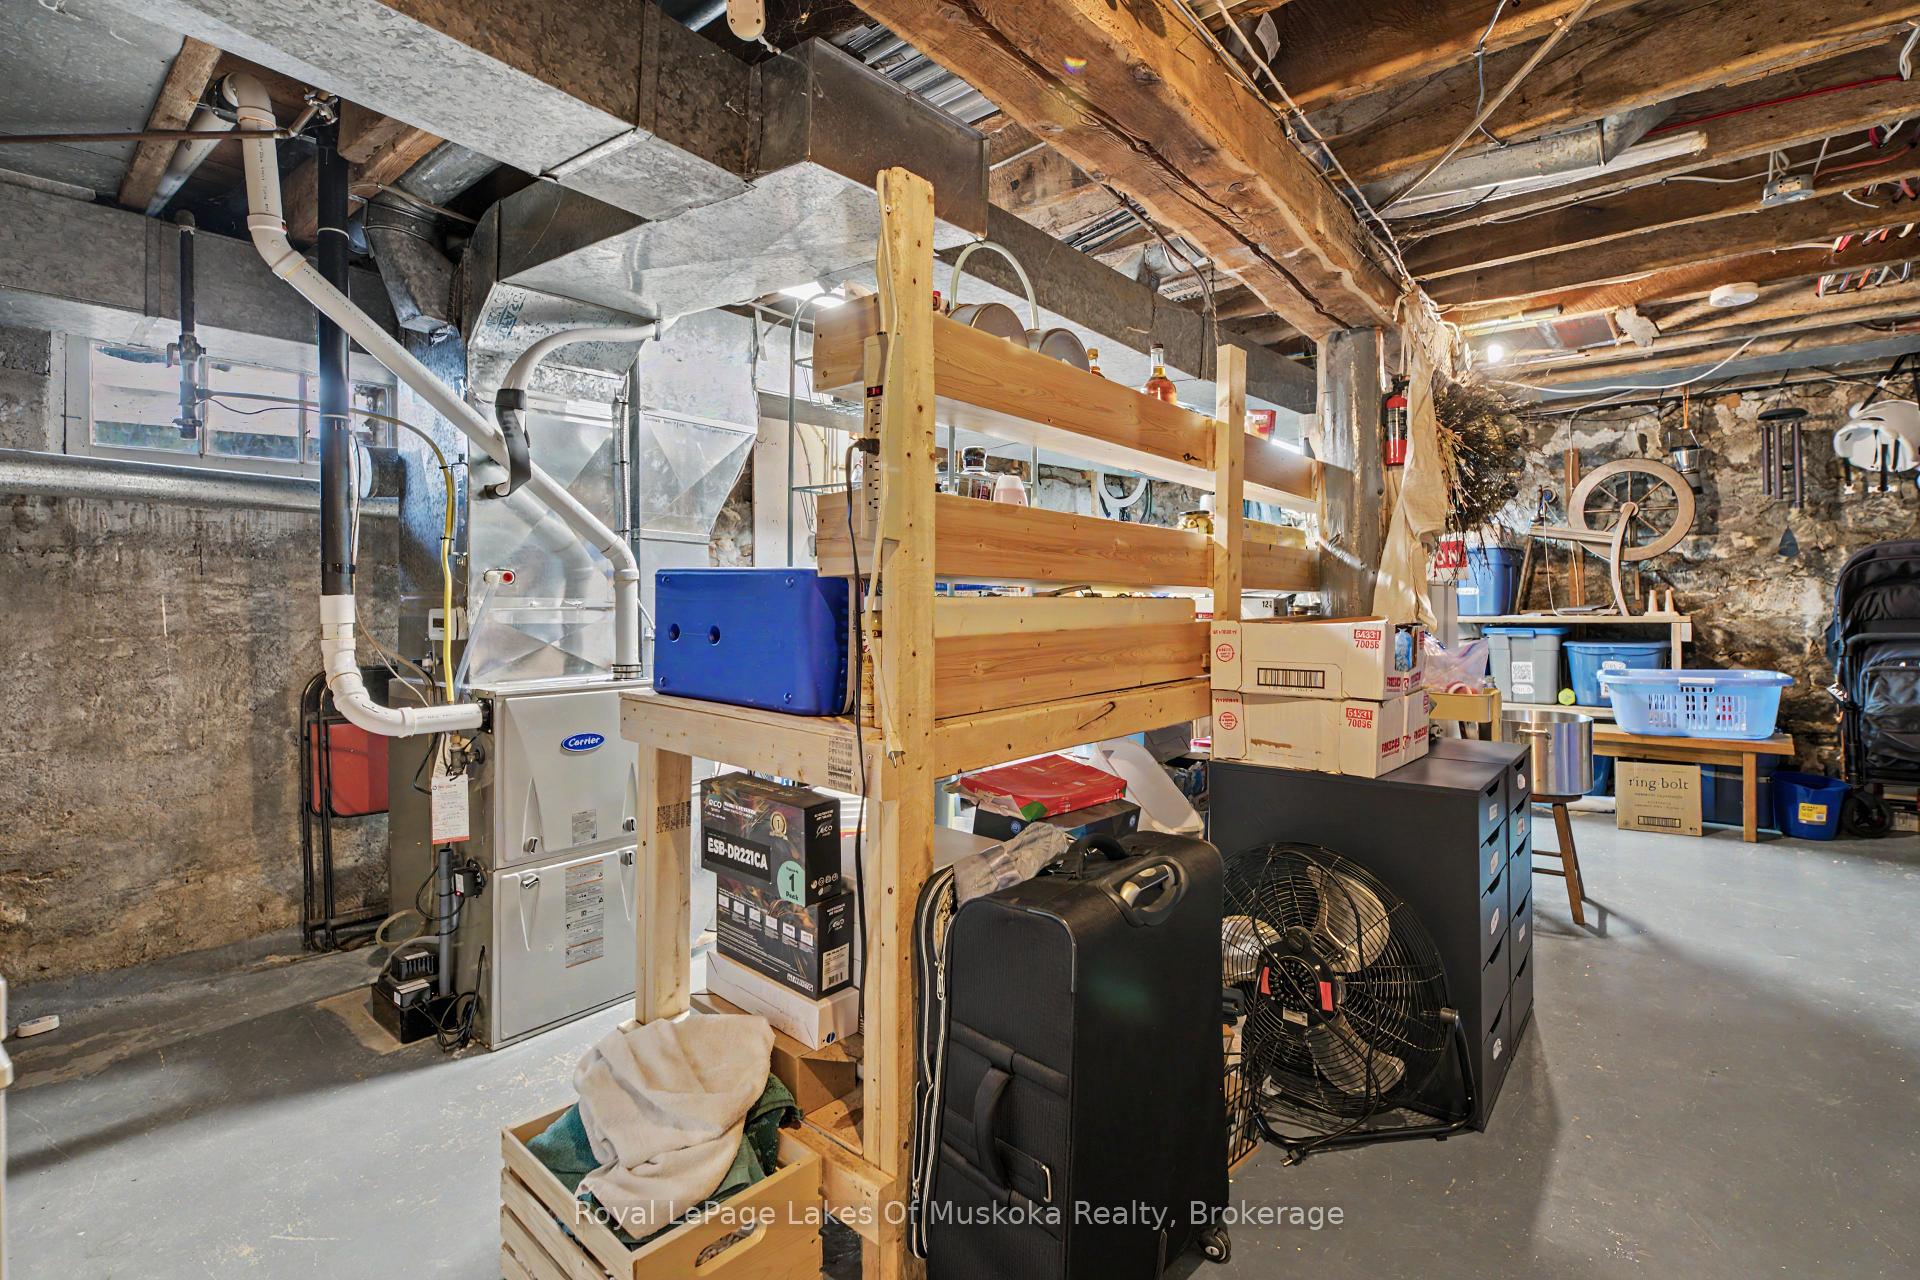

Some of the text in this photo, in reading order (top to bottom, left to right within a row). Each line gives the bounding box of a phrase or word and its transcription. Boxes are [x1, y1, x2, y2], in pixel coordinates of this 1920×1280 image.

[1262, 600, 1269, 608] 12
[568, 737, 601, 747] Carrier
[788, 873, 796, 892] 1
